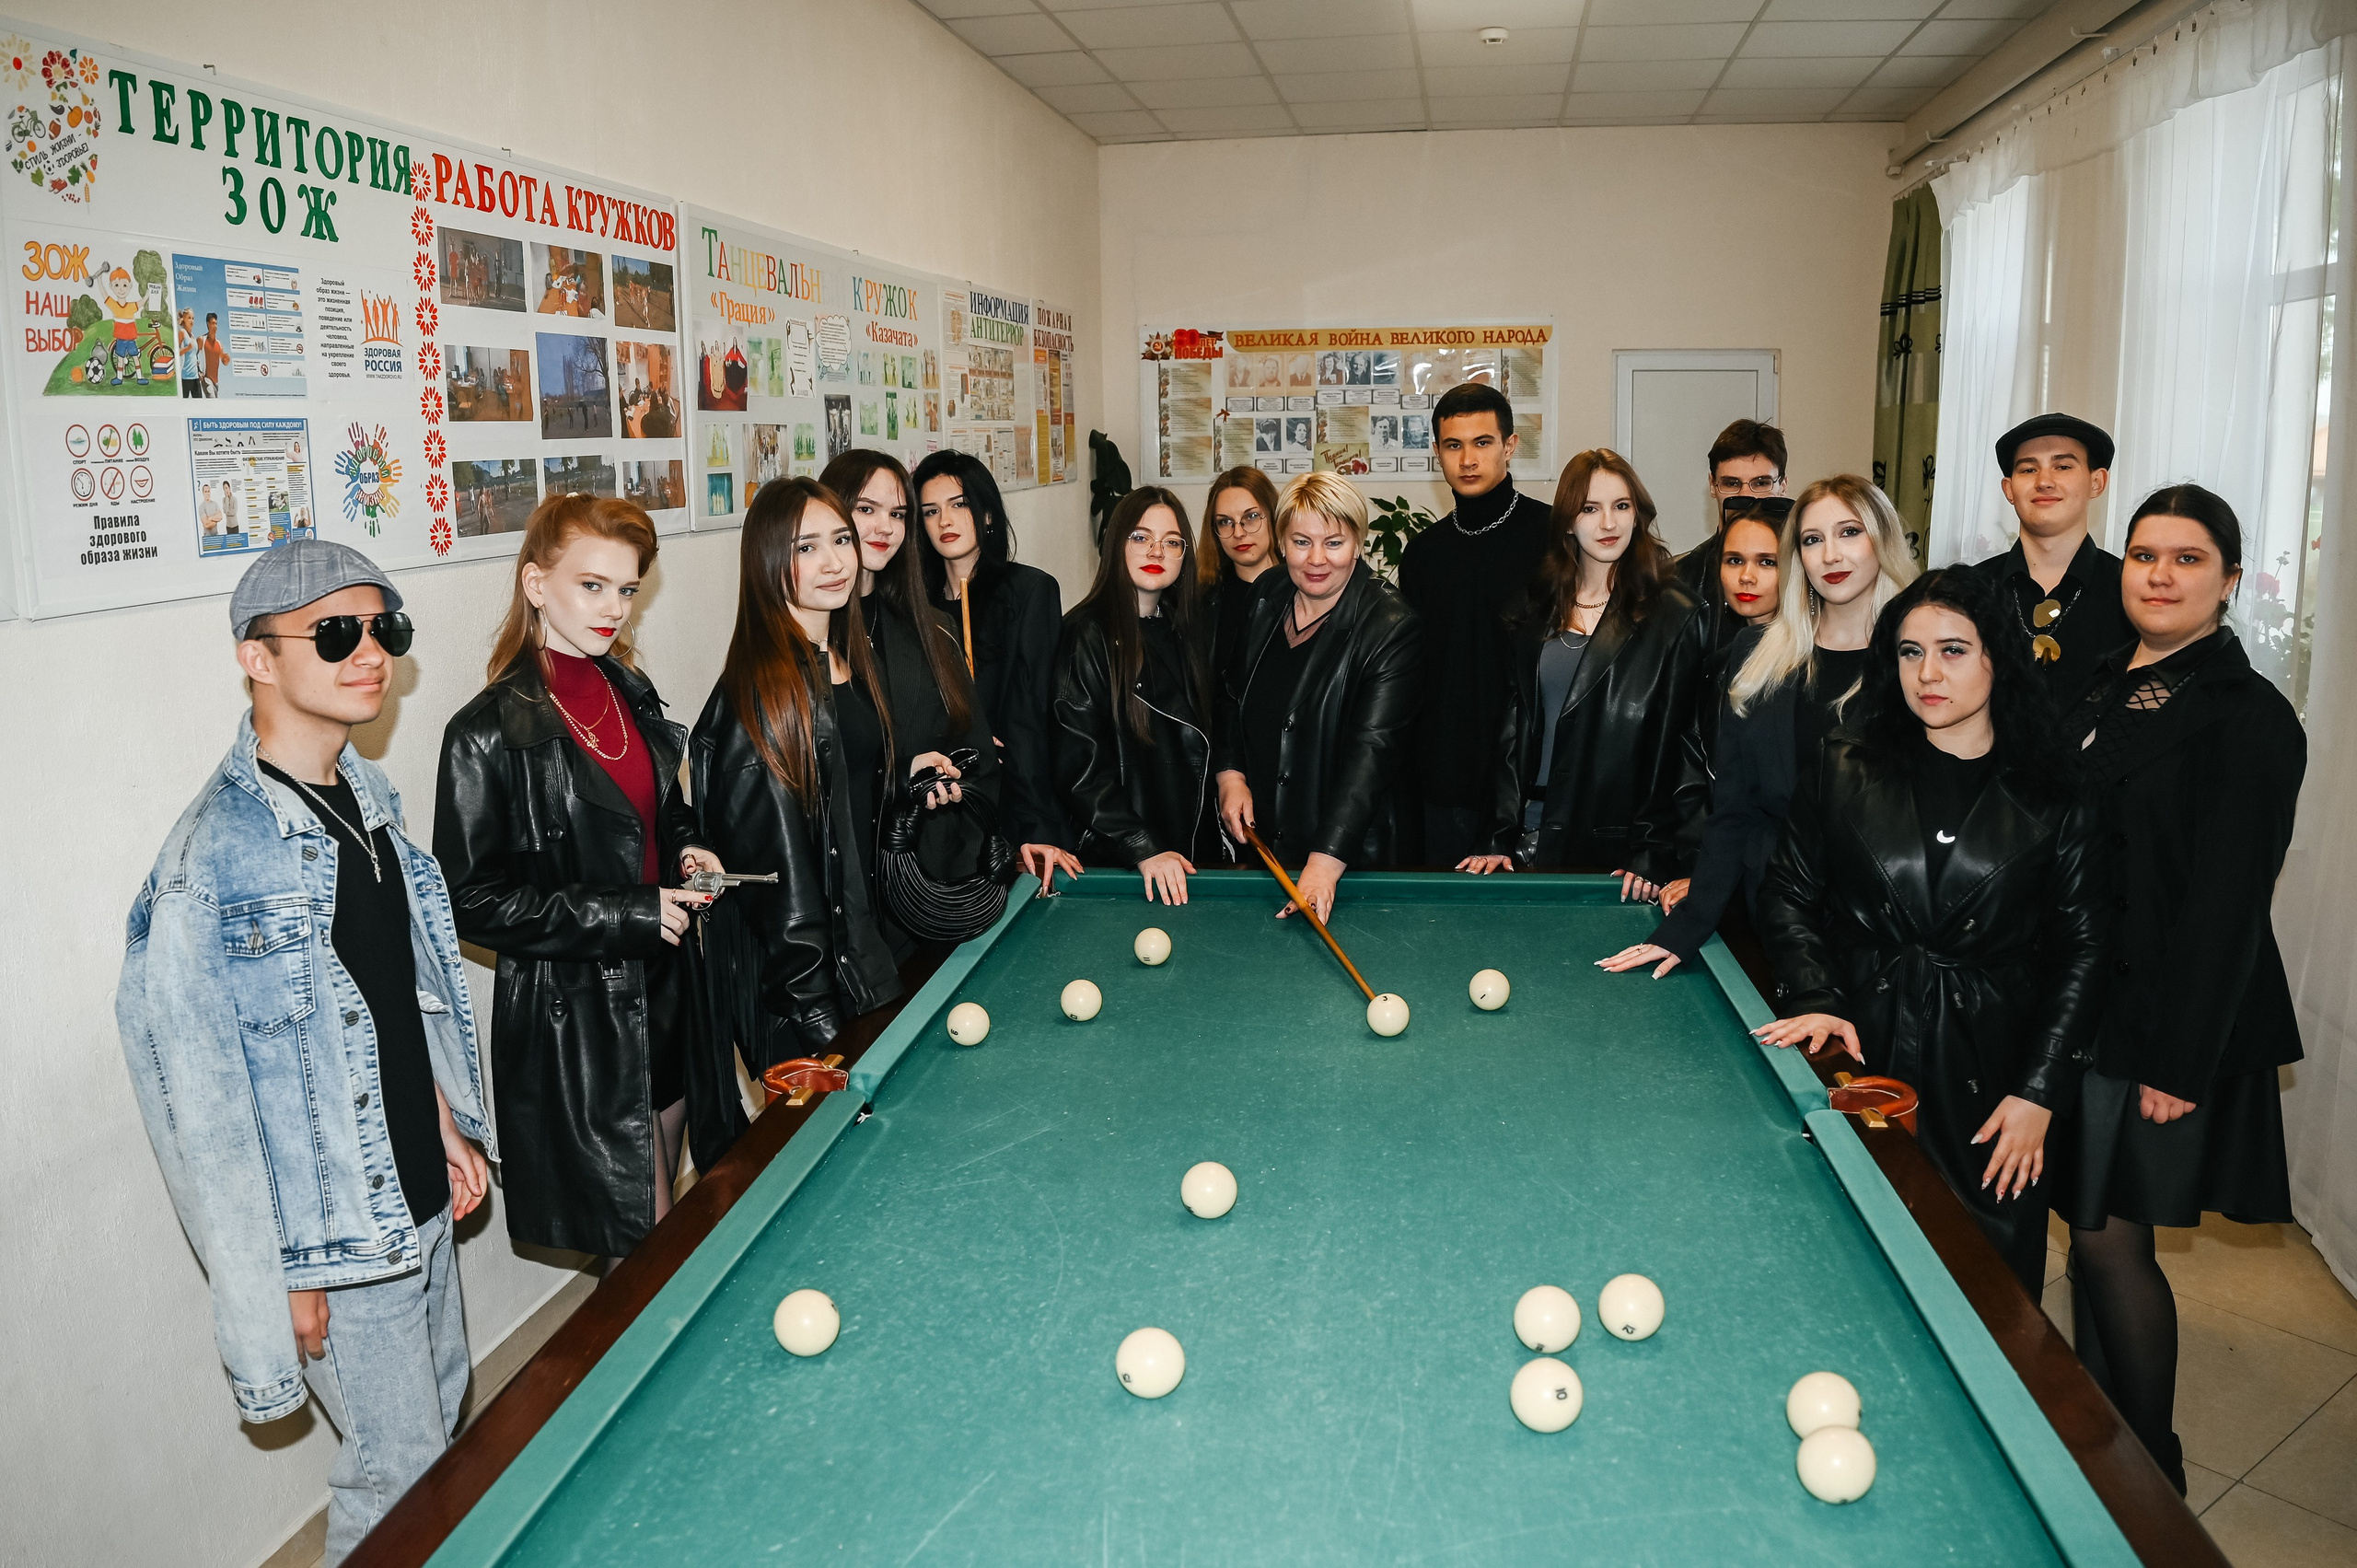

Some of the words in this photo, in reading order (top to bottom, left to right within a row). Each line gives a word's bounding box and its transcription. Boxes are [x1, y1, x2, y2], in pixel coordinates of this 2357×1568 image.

[108, 69, 412, 196] ТЕРРИТОРИЯ
[25, 150, 49, 170] СТИЛЬ
[50, 134, 76, 155] ЖИЗНИ
[222, 166, 340, 243] ЗОЖ
[431, 152, 559, 227] РАБОТА
[564, 185, 676, 251] КРУЖКОВ
[22, 240, 90, 283] ЗОЖ
[175, 273, 193, 283] Образ
[320, 278, 345, 286] Здоровый
[25, 290, 72, 318] НАШ
[710, 291, 775, 329] «Грация»
[852, 276, 918, 321] КРУЖОК
[970, 291, 1029, 325] ИНФОРМАЦИЯ
[970, 316, 1025, 346] АНТИТЕРРОР
[1037, 308, 1073, 332] ПОЖАРНАЯ
[25, 328, 84, 353] ВЫБОР
[320, 342, 354, 350] направленные
[865, 320, 919, 348] «Казачата»
[1033, 329, 1074, 353] БЕЗОПАСНОСТЬ
[1234, 331, 1319, 348] ВЕЛИКАЯ
[1328, 329, 1384, 346] ВОЙНА
[1389, 330, 1476, 345] ВЕЛИКОГО
[1482, 329, 1549, 346] НАРОДА
[364, 347, 401, 359] ЗДОРОВАЯ
[1174, 347, 1224, 360] ПОБЕДЫ
[365, 360, 402, 372] РОССИЯ
[359, 471, 380, 484] ОБРАЗ
[93, 515, 140, 530] Правила
[89, 530, 147, 549] здорового
[80, 550, 120, 565] образа
[122, 546, 158, 562] жизни
[1555, 1388, 1568, 1400] 10
